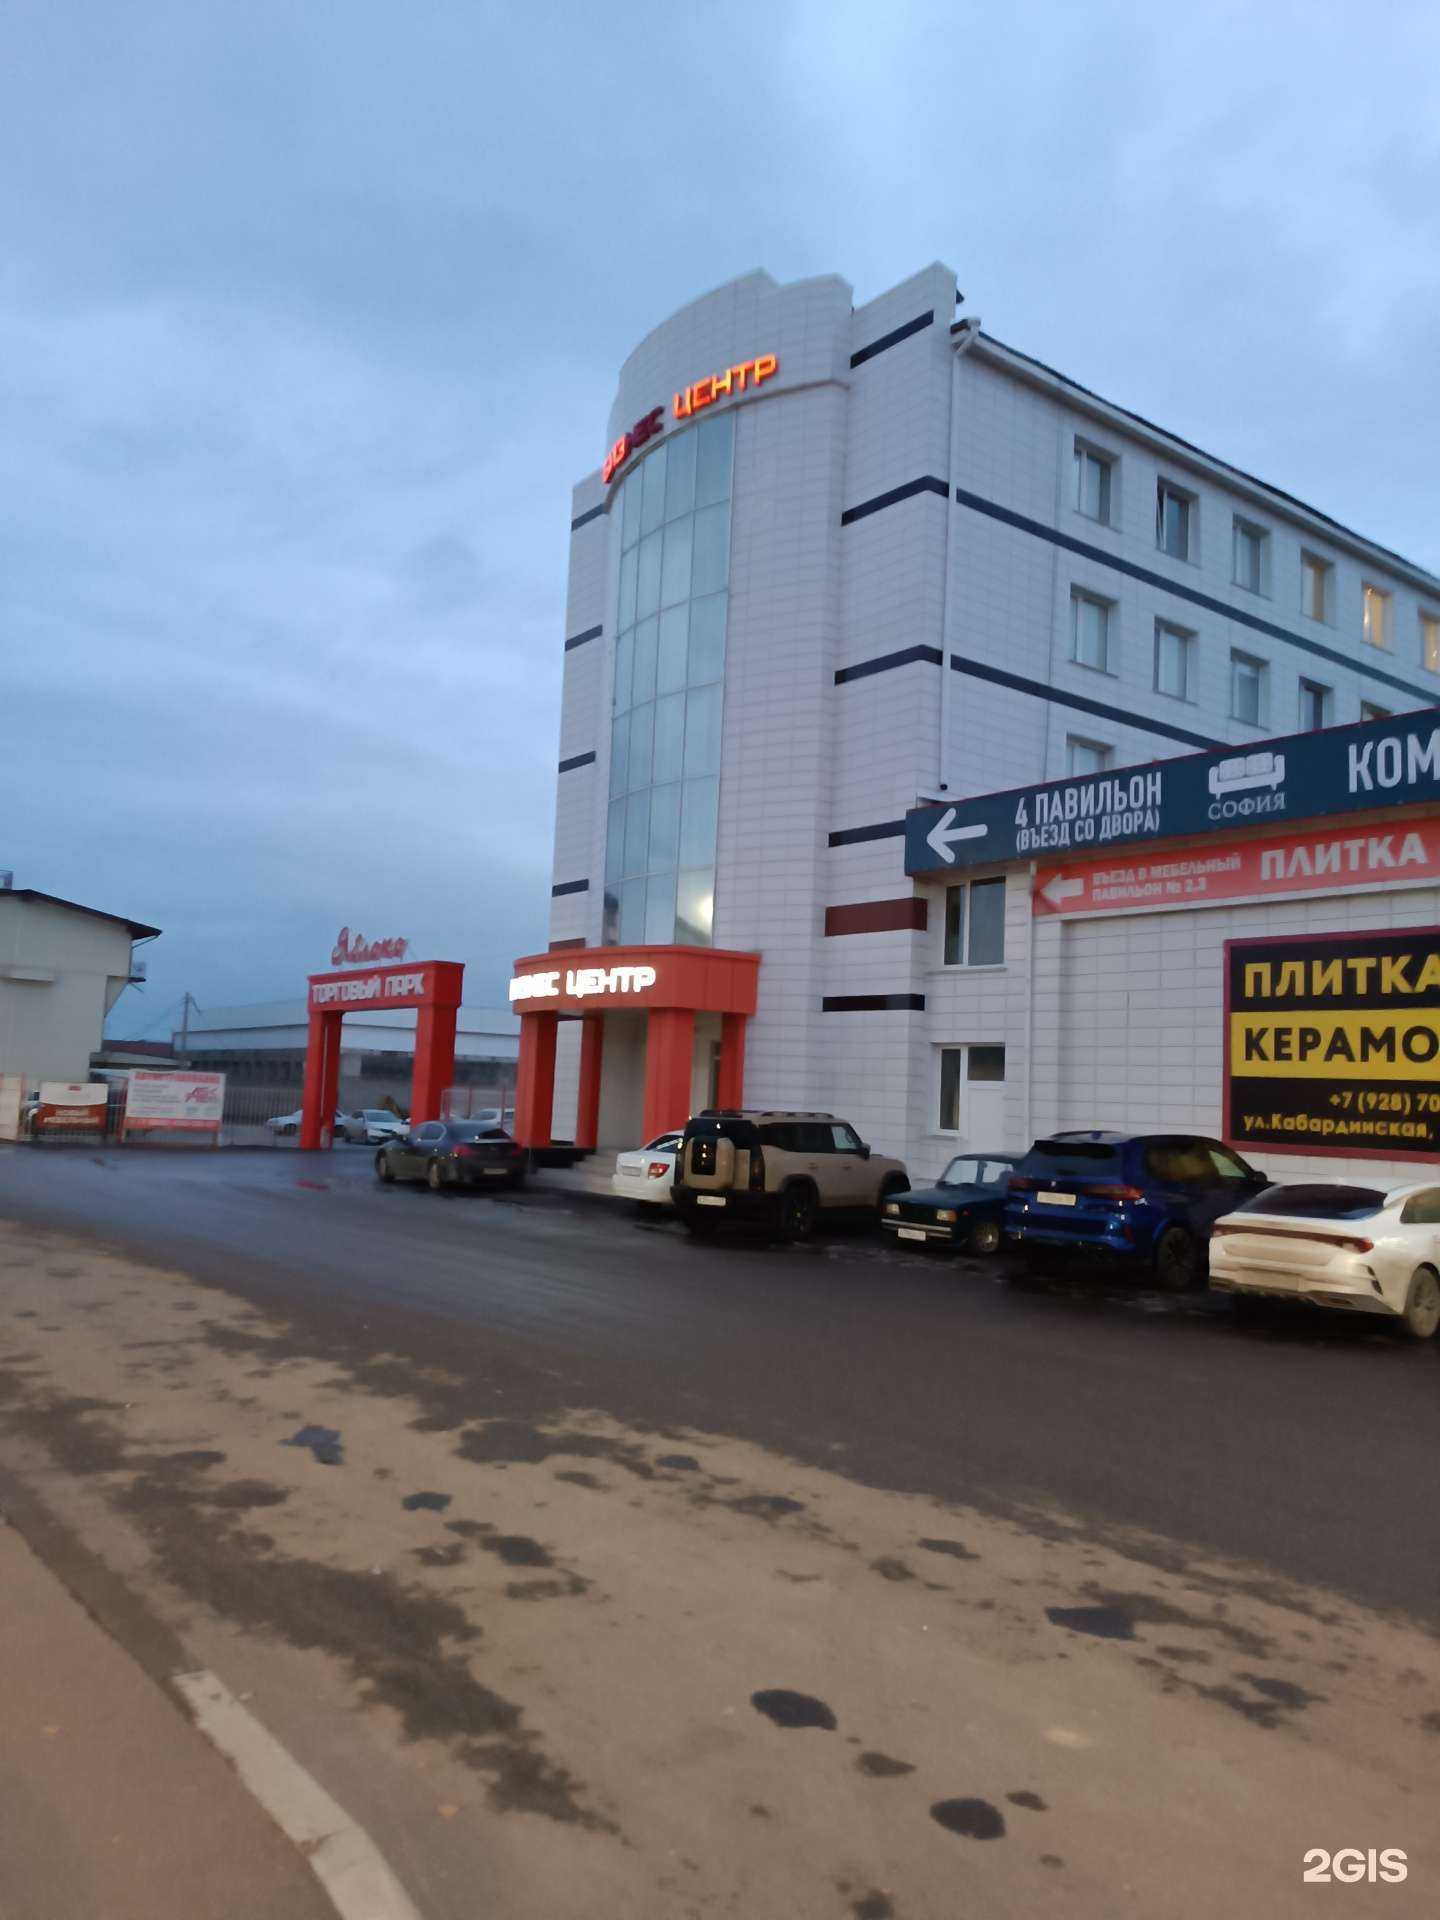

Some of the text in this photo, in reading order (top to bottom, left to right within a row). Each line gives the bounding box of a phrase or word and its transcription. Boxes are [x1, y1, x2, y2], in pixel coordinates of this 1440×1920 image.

[672, 353, 779, 421] ЦЕНТР
[1015, 771, 1162, 828] 4 ПАВИЛЬОН
[1207, 792, 1287, 820] СОФИЯ
[1016, 808, 1160, 853] (ВЪЕЗД СО ДВОРА)
[1259, 832, 1429, 881] ПЛИТКА
[311, 972, 425, 1004] ТОРГОВЫЙ ПАРК
[566, 966, 656, 999] ЦЕНТР
[1244, 953, 1440, 998] ПЛИТКА
[1244, 1025, 1440, 1064] КЕРАМО
